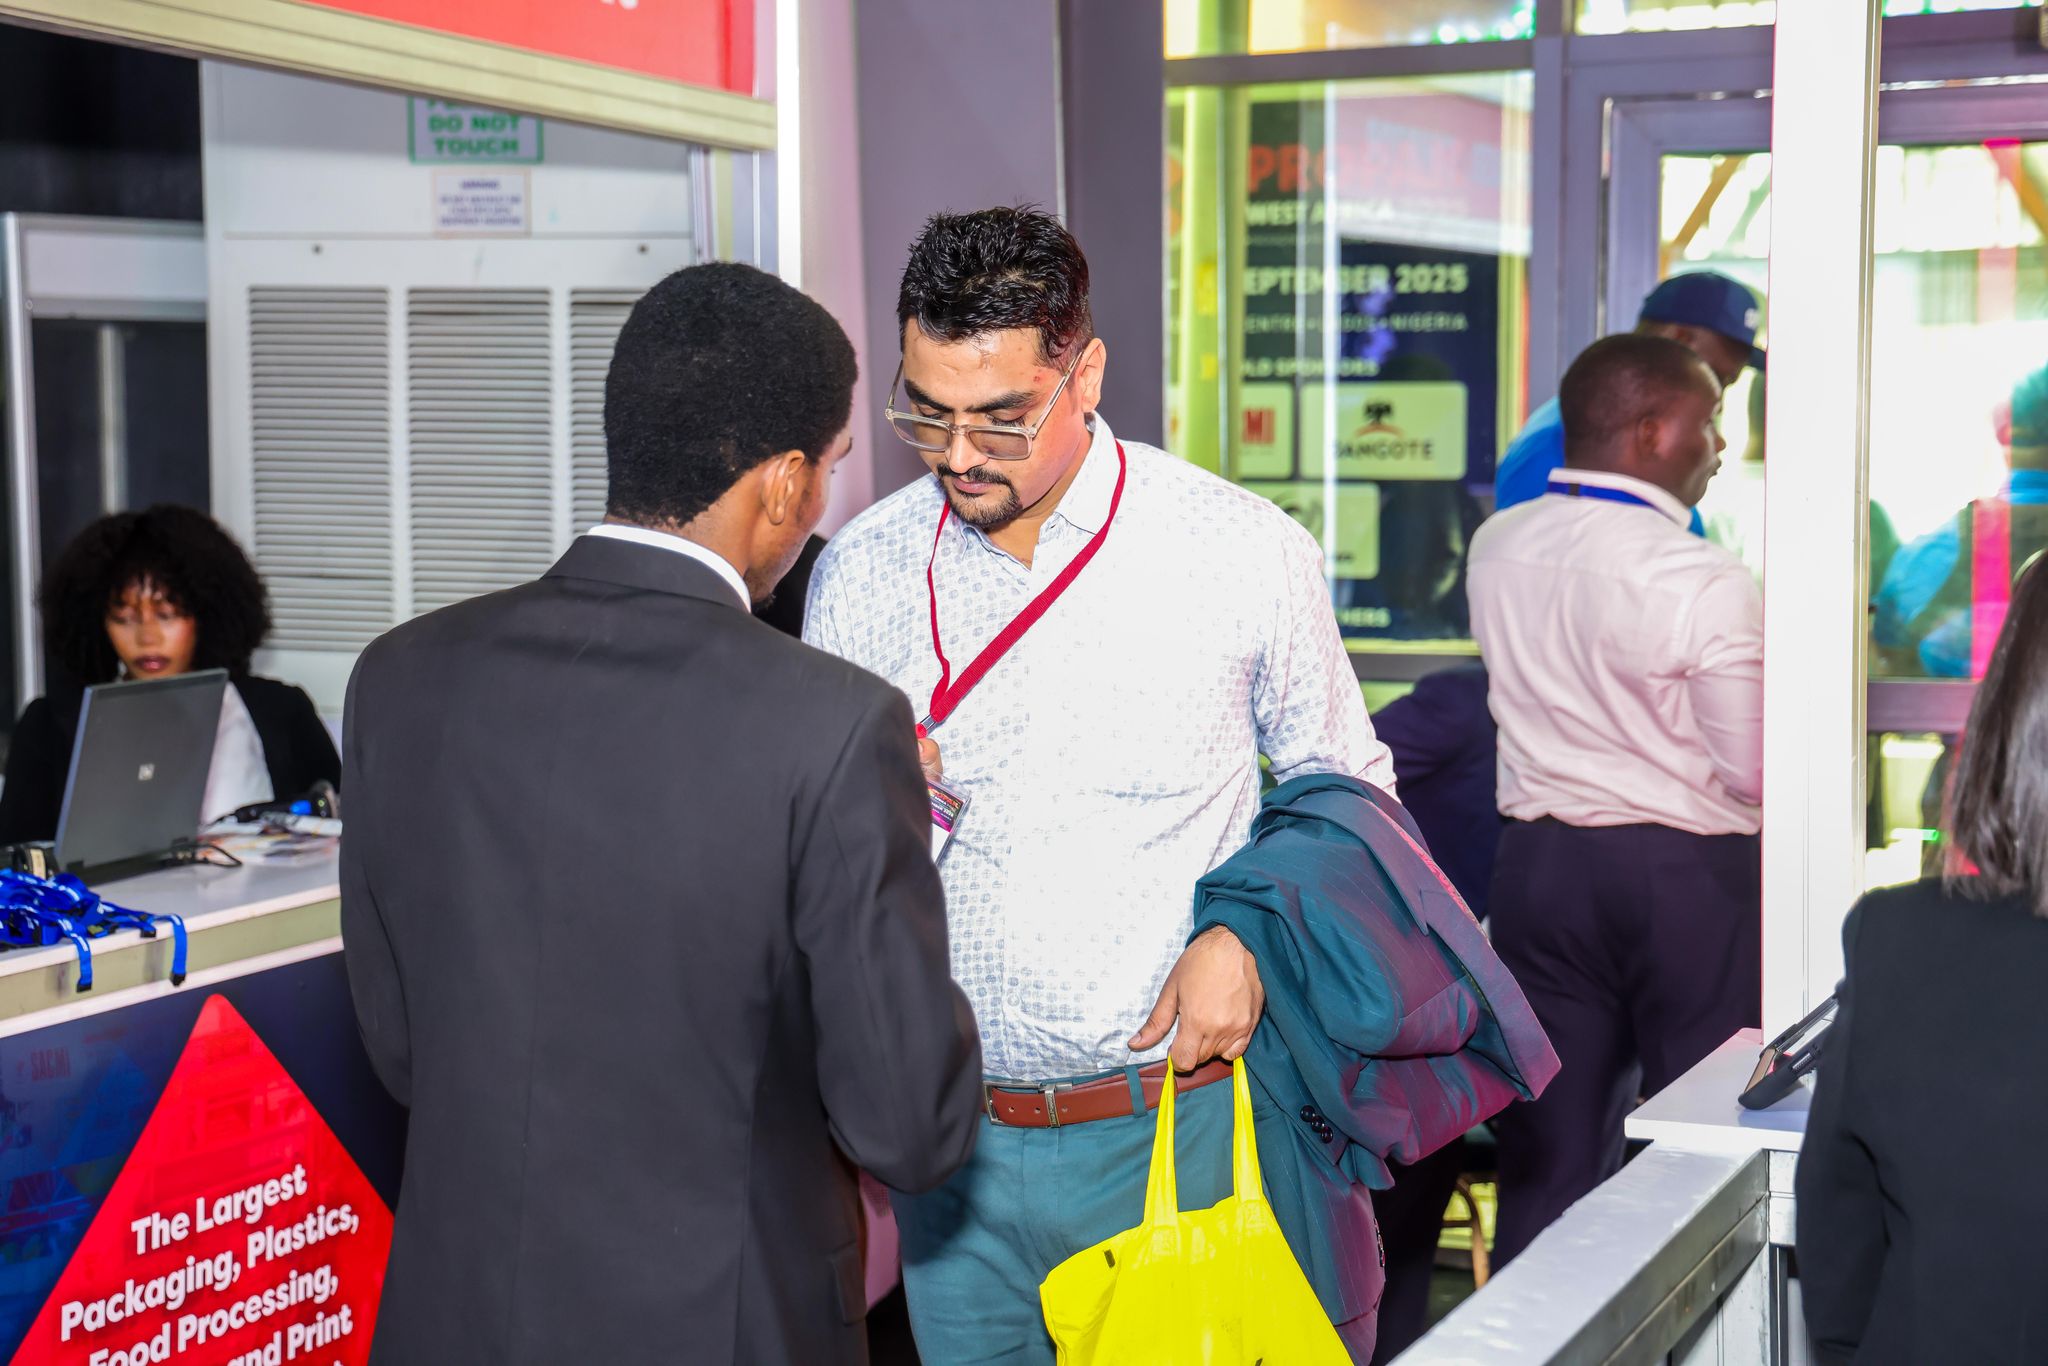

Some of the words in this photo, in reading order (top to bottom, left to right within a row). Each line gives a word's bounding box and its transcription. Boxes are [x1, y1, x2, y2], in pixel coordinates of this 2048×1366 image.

[428, 114, 463, 133] DO
[471, 114, 521, 132] NOT
[434, 137, 519, 154] TOUCH
[1395, 263, 1469, 294] 2025
[1391, 313, 1467, 331] NIGERIA
[1274, 357, 1379, 376] SPONORS
[131, 1212, 190, 1255] The
[196, 1164, 307, 1233] Largest
[61, 1250, 241, 1342] Packaging,
[247, 1204, 359, 1269] Plastics,
[178, 1264, 338, 1353] Processing,
[287, 1304, 353, 1360] Print
